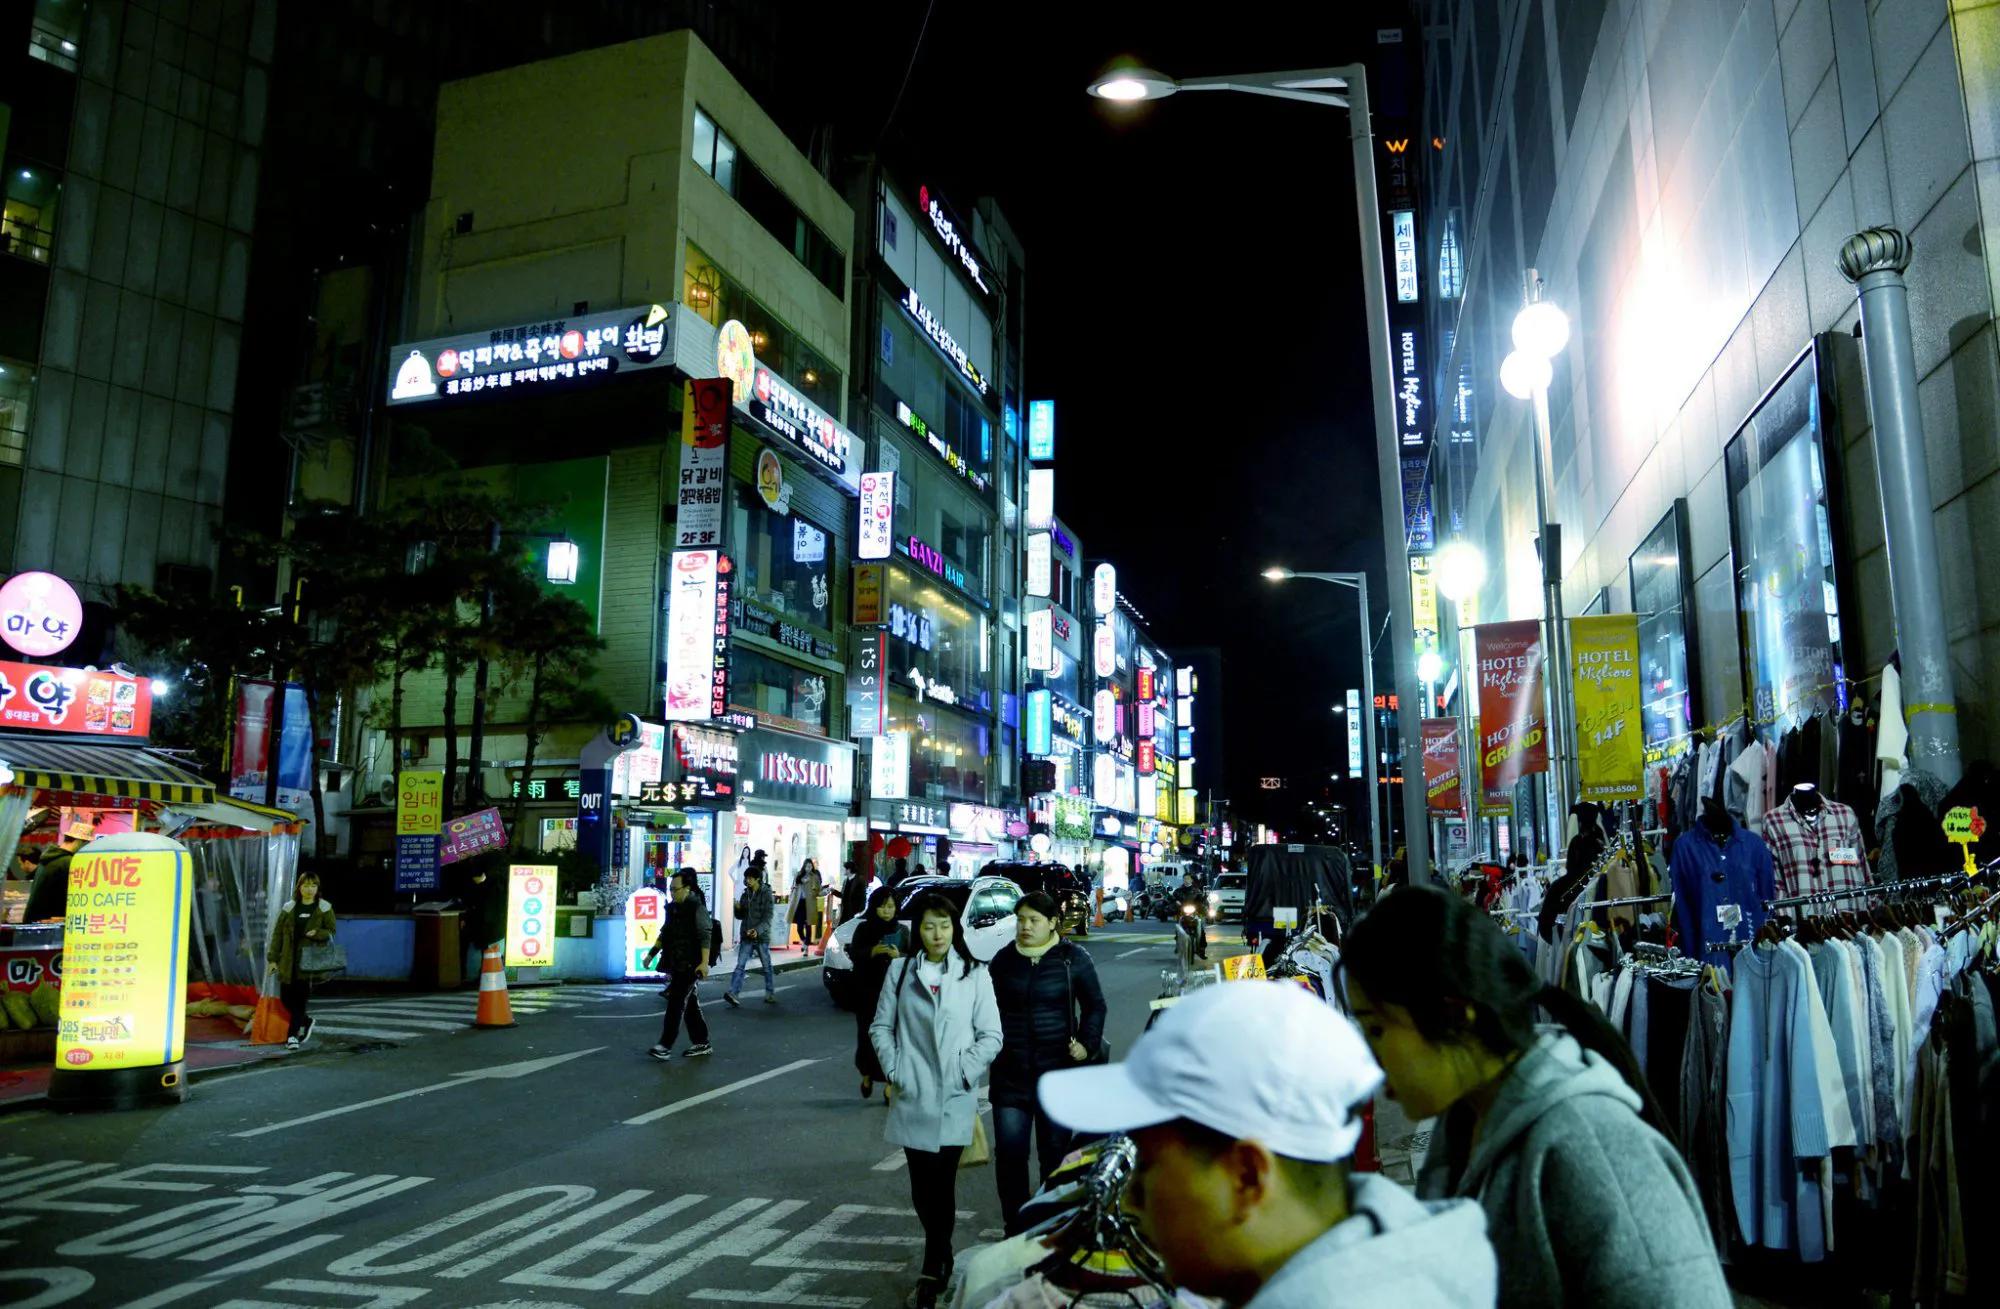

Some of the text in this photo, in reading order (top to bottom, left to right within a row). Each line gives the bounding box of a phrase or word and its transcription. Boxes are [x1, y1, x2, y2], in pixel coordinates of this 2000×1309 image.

[1397, 223, 1414, 292] 세무회계
[1401, 332, 1415, 374] HOTEL
[681, 467, 722, 485] 닭갈비
[681, 530, 716, 544] 2F 3F
[908, 536, 964, 589] GANZI HAIR
[1482, 655, 1537, 671] HOTEL
[1578, 650, 1633, 664] HOTEL
[1579, 665, 1632, 688] Migliore
[1583, 696, 1634, 732] OPEN
[1488, 714, 1540, 747] HOTEL
[1593, 719, 1626, 746] 14F
[1485, 729, 1543, 768] GRAND
[1429, 769, 1456, 786] HOTEL
[642, 782, 660, 801] 元
[662, 782, 676, 802] $
[681, 783, 697, 800] ¥
[1427, 777, 1458, 798] GRAND
[1595, 784, 1638, 795] 3393-6500
[403, 791, 438, 808] 임대
[582, 793, 602, 809] OUT
[400, 814, 438, 831] 문의
[93, 892, 136, 907] CAFE
